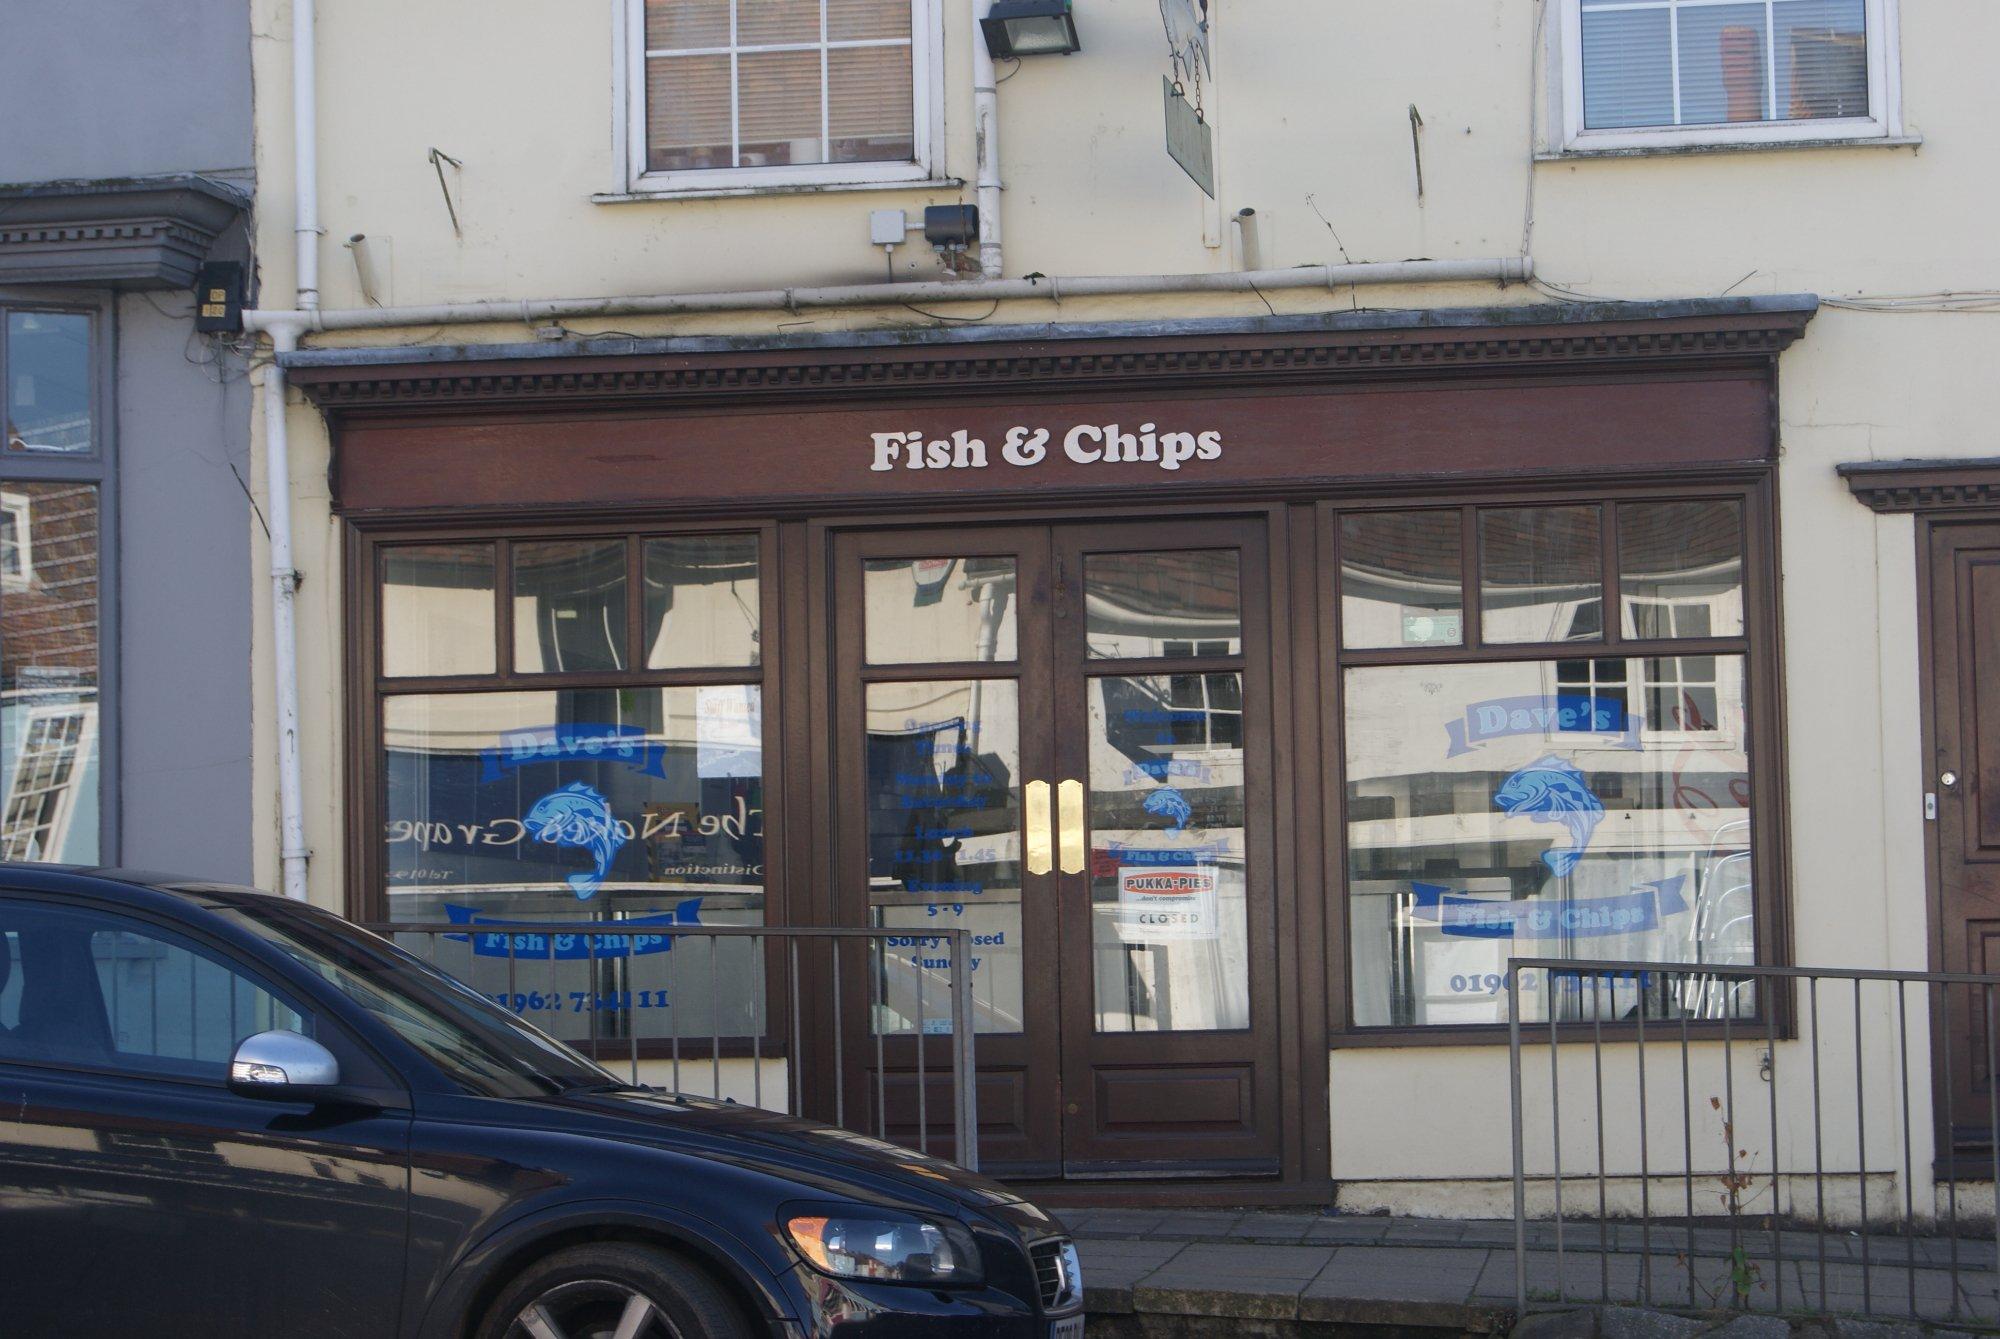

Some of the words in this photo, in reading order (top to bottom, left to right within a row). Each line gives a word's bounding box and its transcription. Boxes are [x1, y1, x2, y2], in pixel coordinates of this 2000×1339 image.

[870, 430, 989, 471] Fish
[1002, 426, 1050, 467] &
[1063, 422, 1222, 471] Chips
[1475, 701, 1612, 733] Dave's
[509, 729, 635, 760] Dave's
[927, 902, 938, 917] 5
[952, 902, 964, 917] 9
[1139, 913, 1199, 924] CLOSED
[1561, 906, 1645, 930] Chips
[485, 934, 545, 952] Fish
[584, 934, 662, 951] Chips
